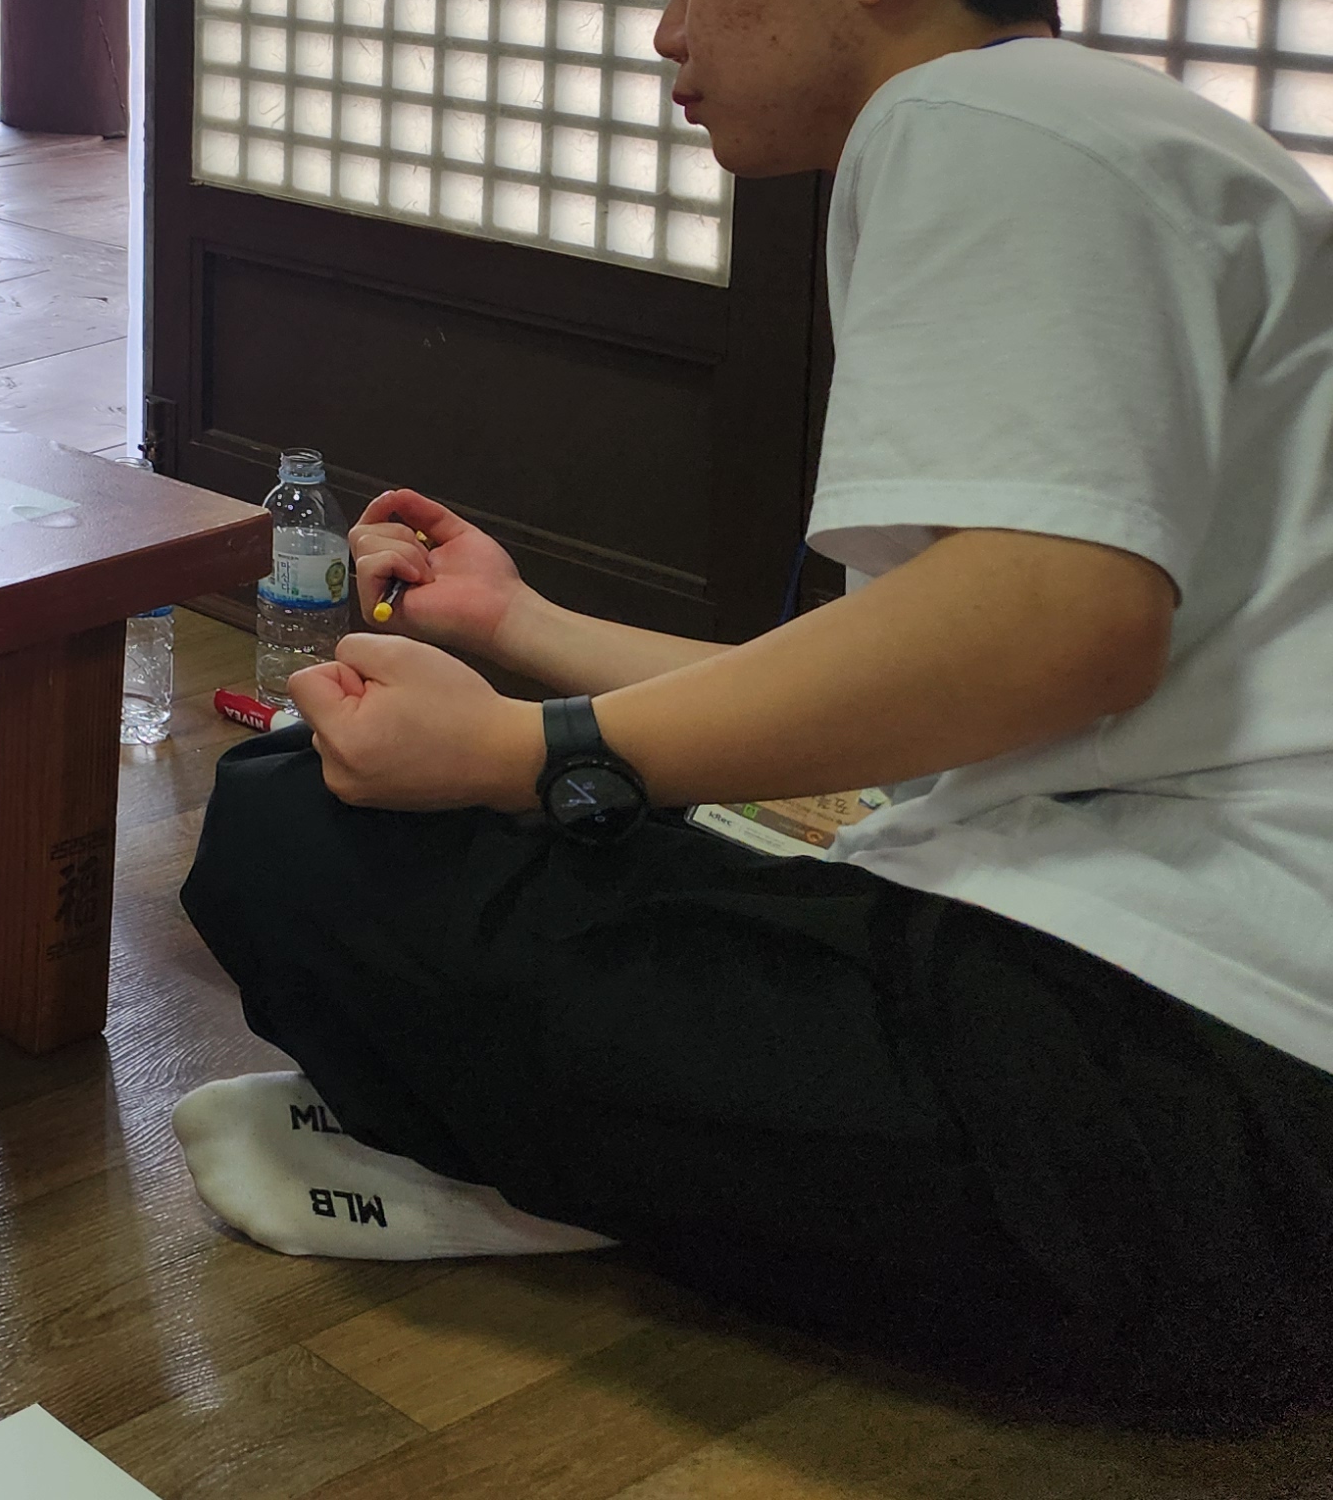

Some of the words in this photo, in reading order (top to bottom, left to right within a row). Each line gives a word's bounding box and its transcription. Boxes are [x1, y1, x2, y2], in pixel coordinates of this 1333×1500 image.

[224, 706, 264, 731] NIVEA
[289, 1104, 345, 1135] ML
[309, 1187, 388, 1228] MLB
